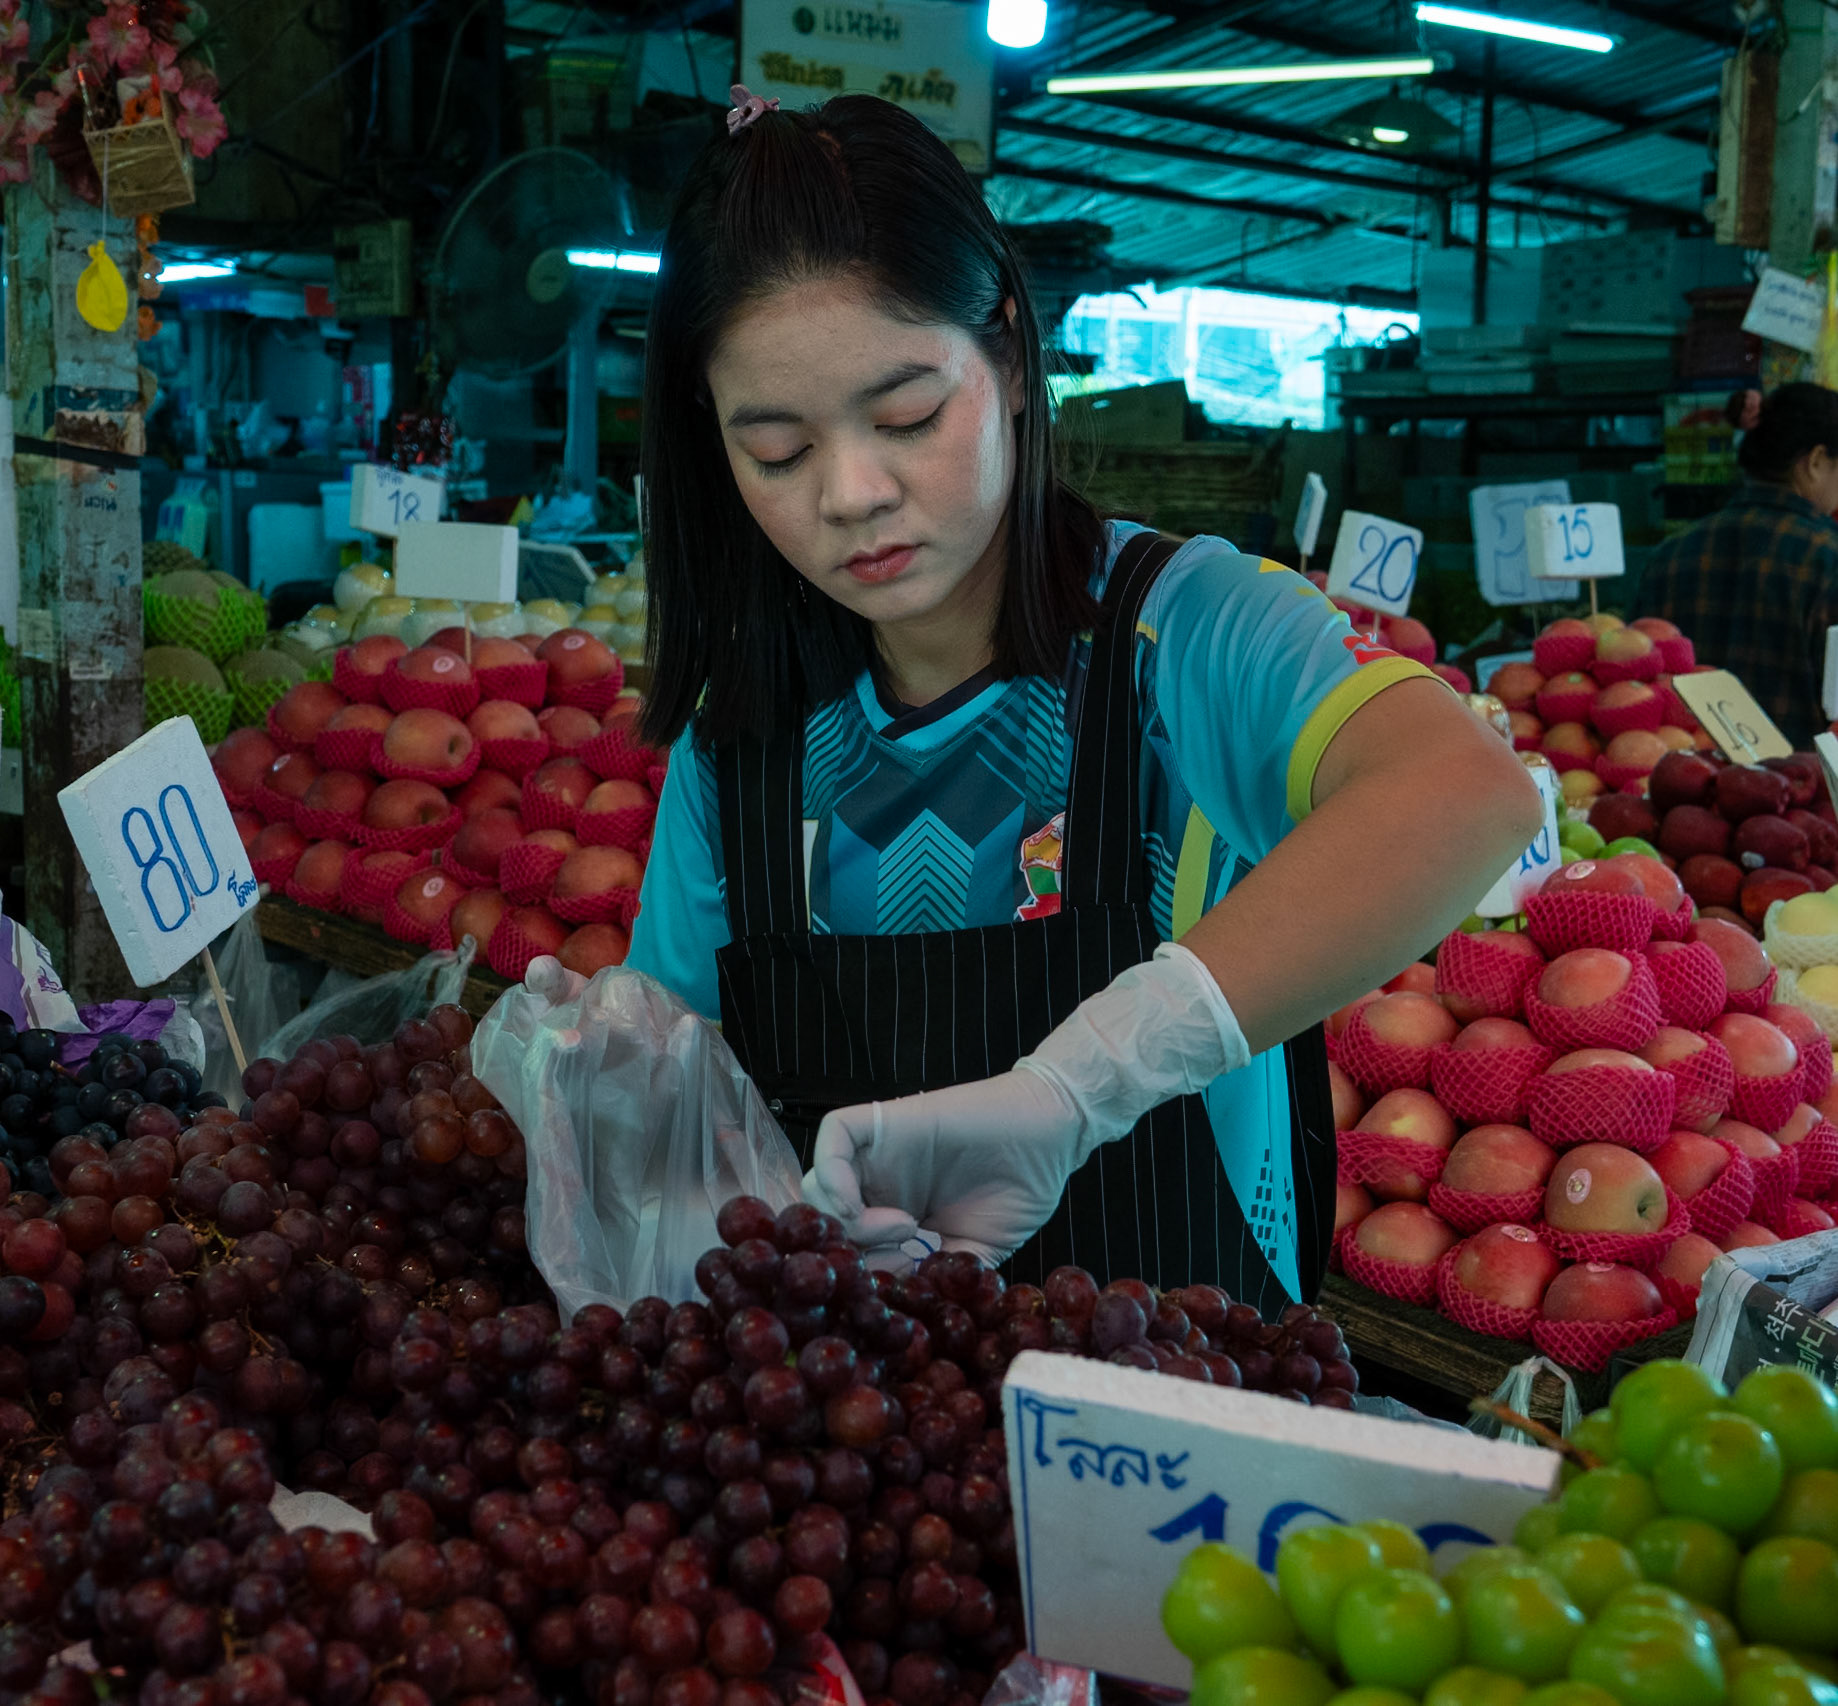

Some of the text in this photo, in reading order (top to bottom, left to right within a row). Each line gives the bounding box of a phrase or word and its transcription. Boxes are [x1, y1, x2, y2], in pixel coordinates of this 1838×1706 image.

[1350, 525, 1419, 602] 20
[1557, 507, 1594, 562] 15
[1706, 700, 1760, 751] 16
[121, 784, 220, 932] 80
[1025, 1394, 1190, 1490] โลละ
